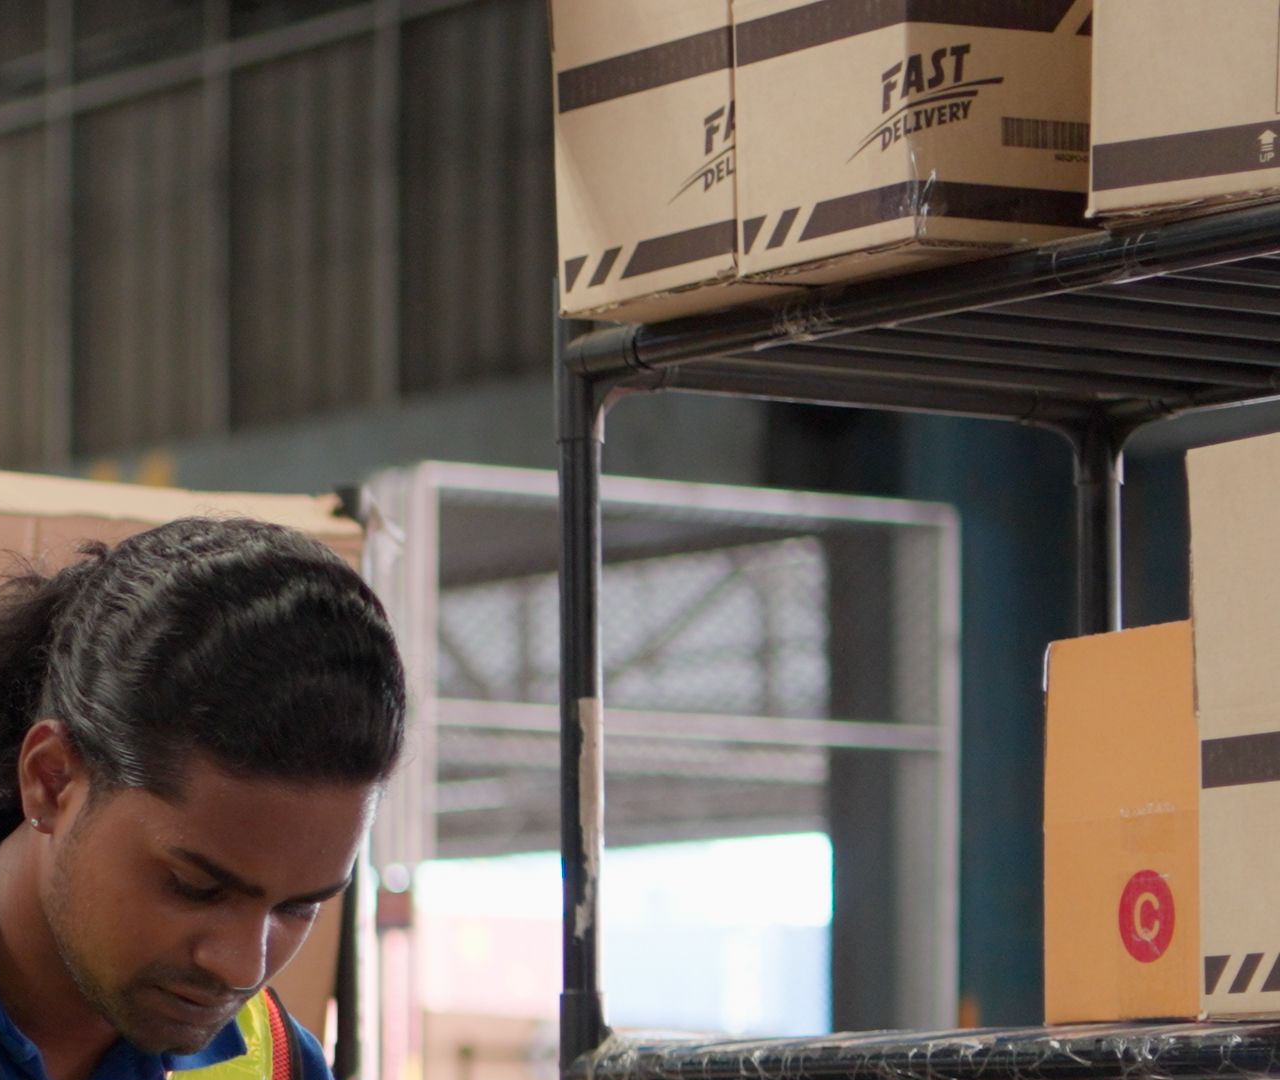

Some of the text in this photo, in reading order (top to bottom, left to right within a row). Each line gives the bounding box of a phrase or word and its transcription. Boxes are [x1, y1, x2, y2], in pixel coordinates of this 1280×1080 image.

[880, 43, 972, 115] FAST
[879, 100, 973, 152] DELIVERY
[1258, 151, 1275, 164] UP
[1133, 891, 1161, 942] C
